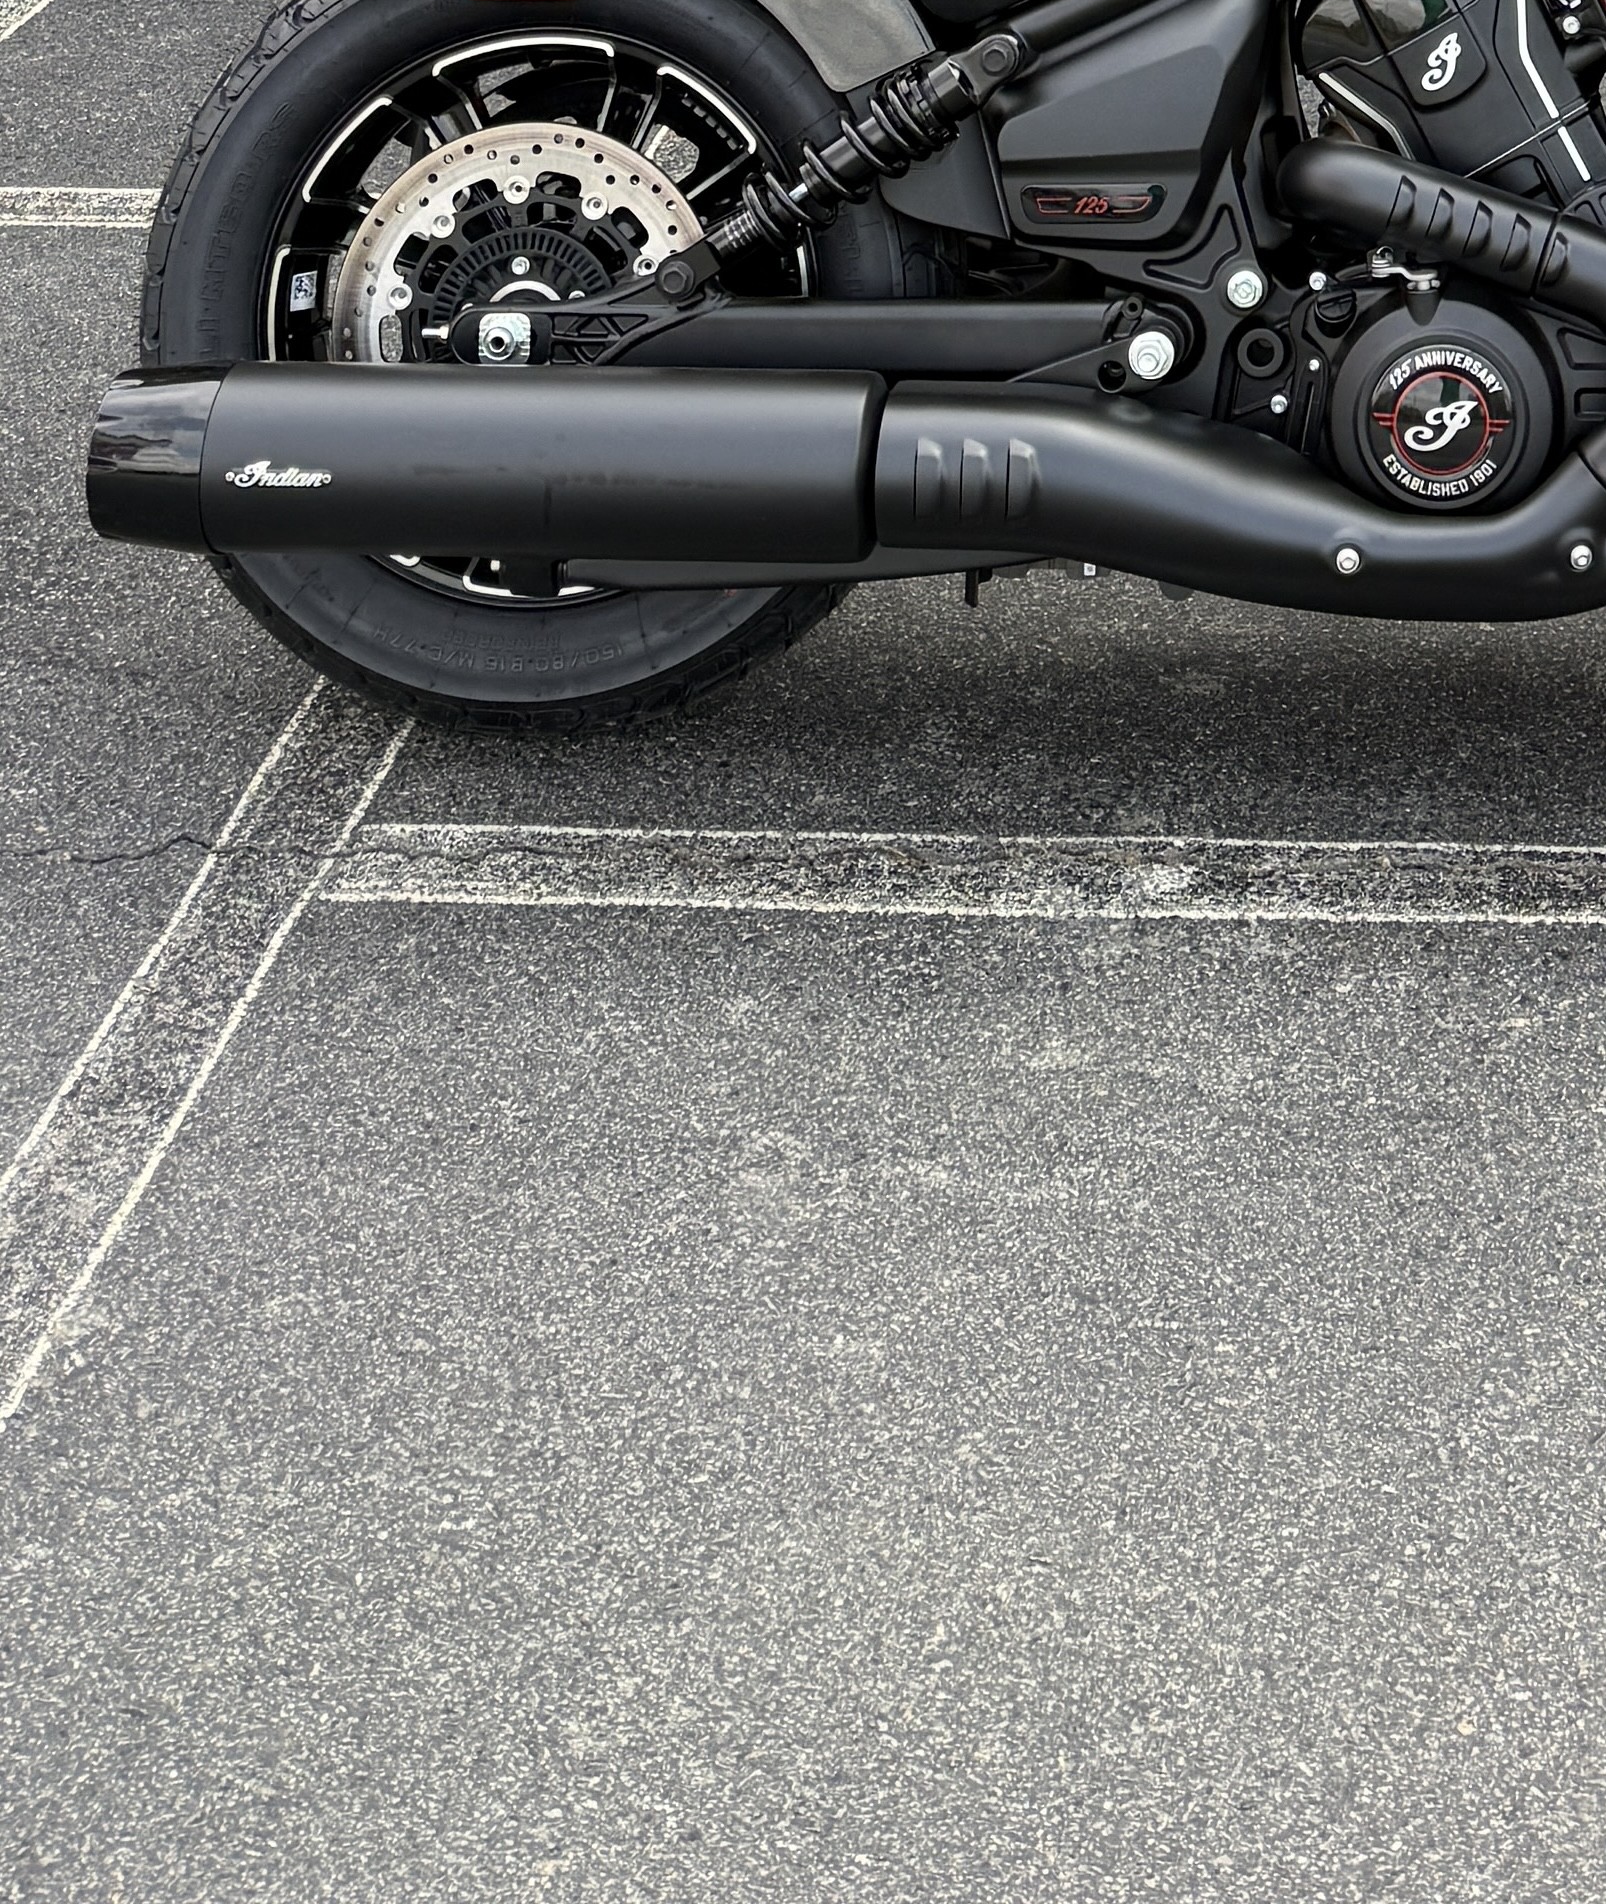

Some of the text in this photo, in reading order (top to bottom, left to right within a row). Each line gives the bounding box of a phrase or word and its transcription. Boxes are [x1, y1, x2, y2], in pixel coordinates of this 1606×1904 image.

[1074, 195, 1110, 213] 125
[1414, 350, 1503, 394] ANNIVERSARY
[233, 460, 322, 488] Indian
[1382, 453, 1498, 497] ESTABLISHED 1901
